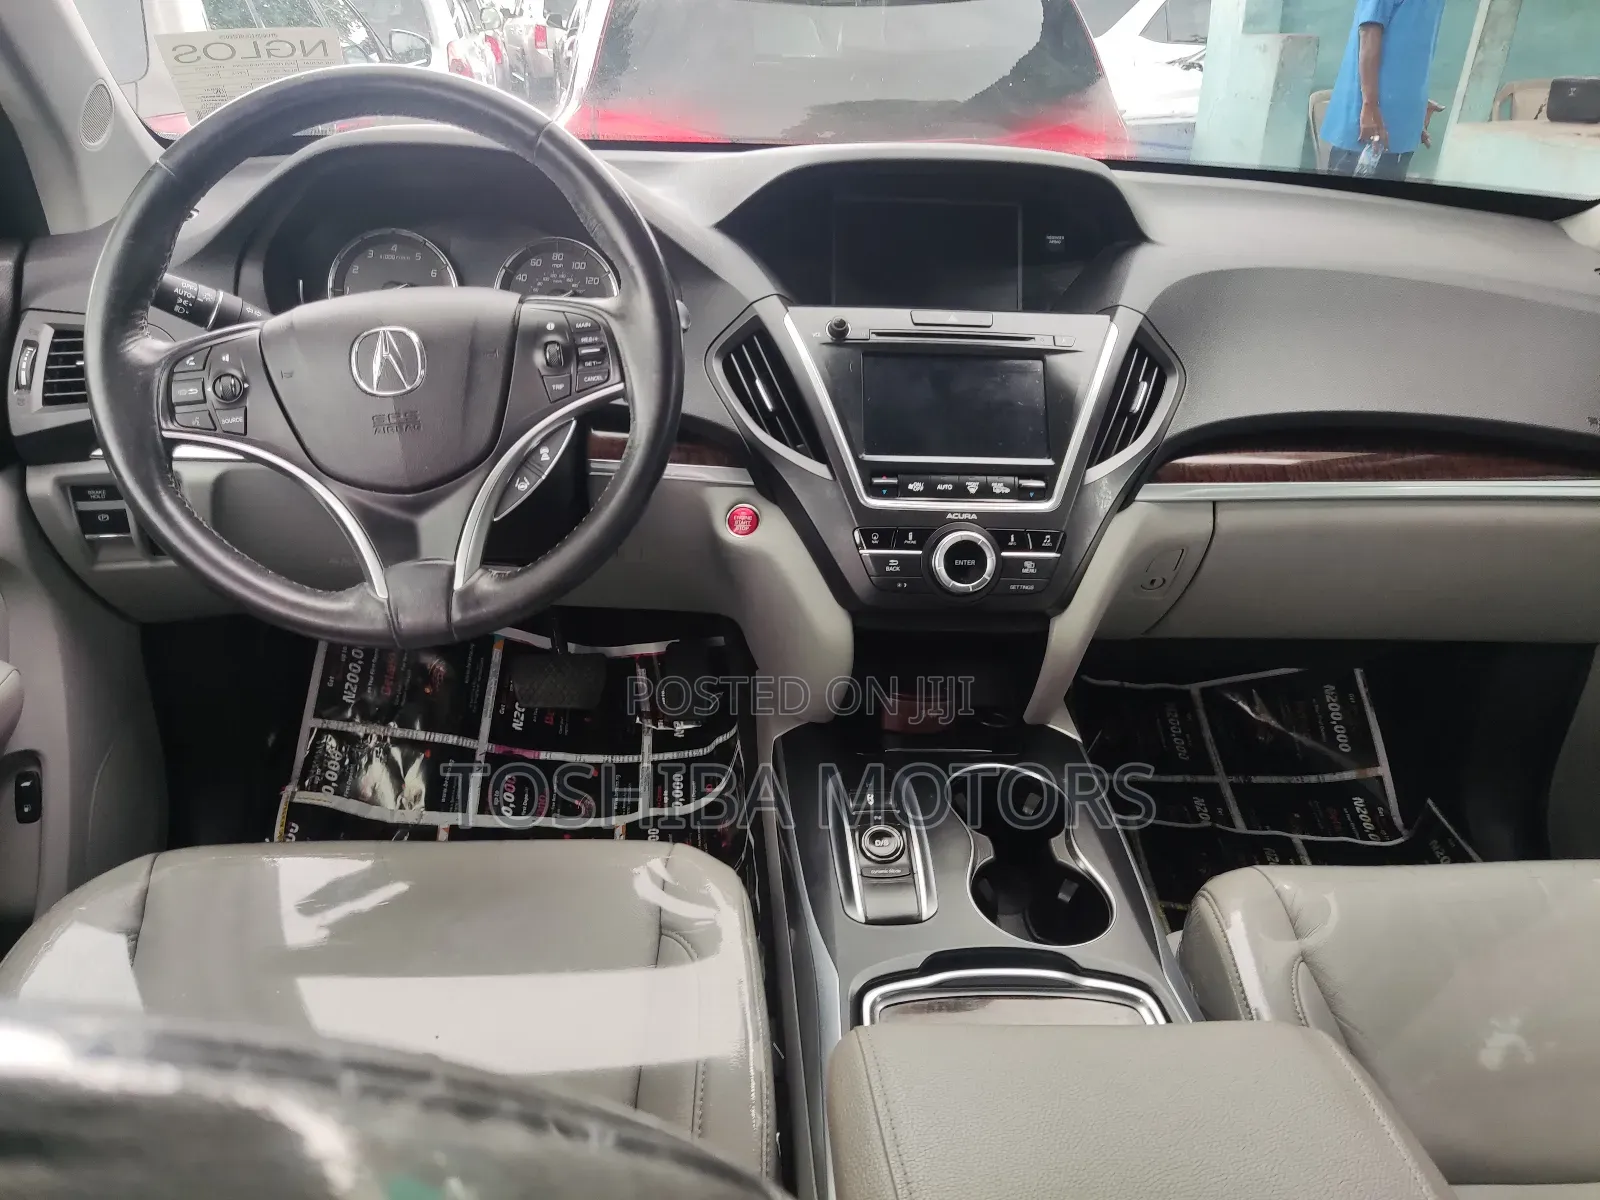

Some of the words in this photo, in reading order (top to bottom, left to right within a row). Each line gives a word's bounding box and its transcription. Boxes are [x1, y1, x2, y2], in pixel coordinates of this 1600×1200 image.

[390, 244, 398, 252] 4
[367, 250, 374, 258] 3
[552, 252, 564, 261] 80
[530, 258, 542, 266] 60
[572, 262, 587, 270] 100
[352, 265, 359, 274] 2
[430, 269, 438, 278] 6
[516, 273, 528, 282] 40
[585, 276, 600, 285] 120
[174, 287, 192, 299] AUTO
[222, 416, 243, 424] SOURCE
